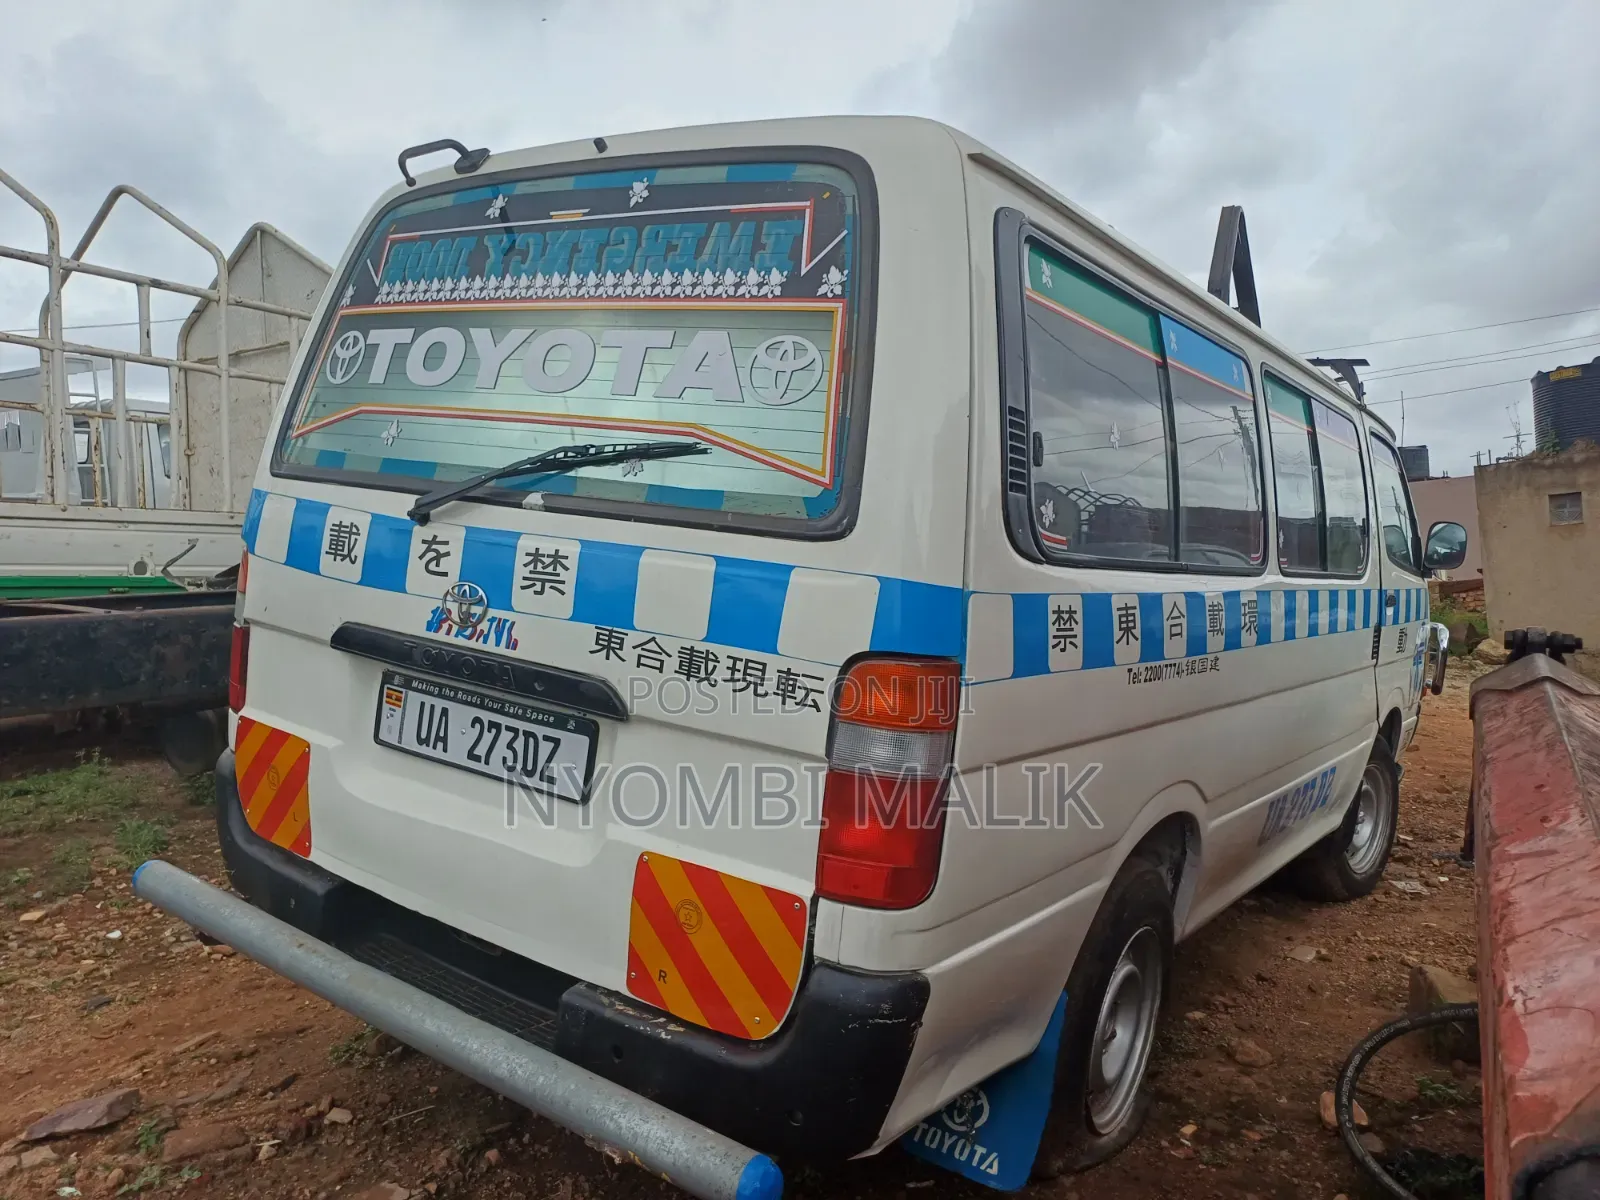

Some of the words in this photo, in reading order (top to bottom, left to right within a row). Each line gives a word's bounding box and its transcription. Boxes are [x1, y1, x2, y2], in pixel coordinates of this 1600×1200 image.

[365, 326, 745, 403] TOYOTA
[403, 641, 517, 690] TOYOTA
[1127, 667, 1142, 685] Tel:
[411, 679, 440, 696] Making
[441, 684, 455, 699] the
[457, 690, 481, 704] Roads
[484, 697, 502, 710] Your
[504, 703, 523, 717] Safe
[526, 709, 555, 723] Space
[416, 700, 450, 754] UA
[466, 715, 562, 786] 273DZ
[657, 969, 668, 985] R
[913, 1122, 1000, 1176] TOYOTA
